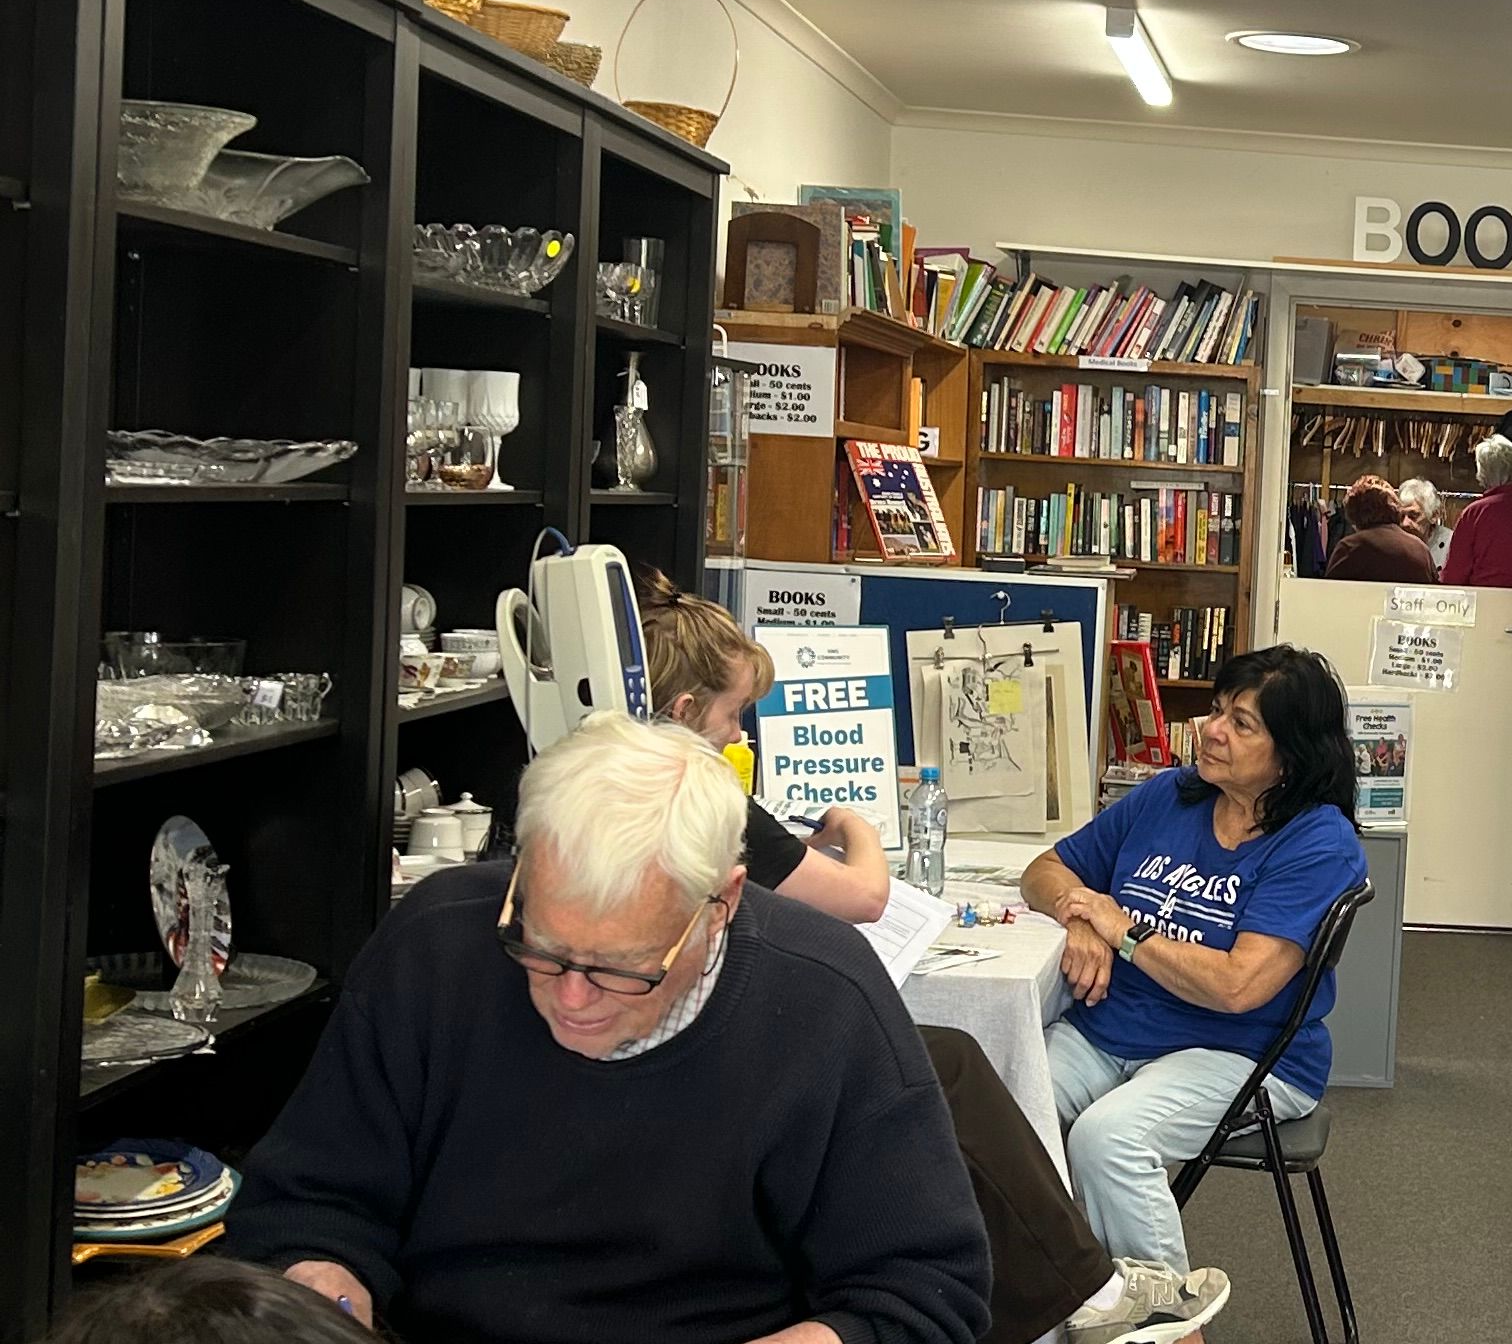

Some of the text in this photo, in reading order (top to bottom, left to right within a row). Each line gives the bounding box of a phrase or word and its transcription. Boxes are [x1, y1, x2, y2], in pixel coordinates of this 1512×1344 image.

[755, 363, 802, 377] OOKS
[769, 380, 783, 389] 50
[768, 590, 826, 605] BOOKS
[1391, 597, 1470, 616] Staff Only
[756, 606, 784, 616] Small
[793, 608, 807, 617] 50
[810, 610, 837, 618] cents
[1397, 635, 1437, 648] BOOKS
[783, 680, 869, 712] FREE
[793, 723, 864, 746] Blood
[775, 755, 885, 776] Pressure
[787, 781, 877, 803] Checks
[1132, 855, 1172, 880] LOS
